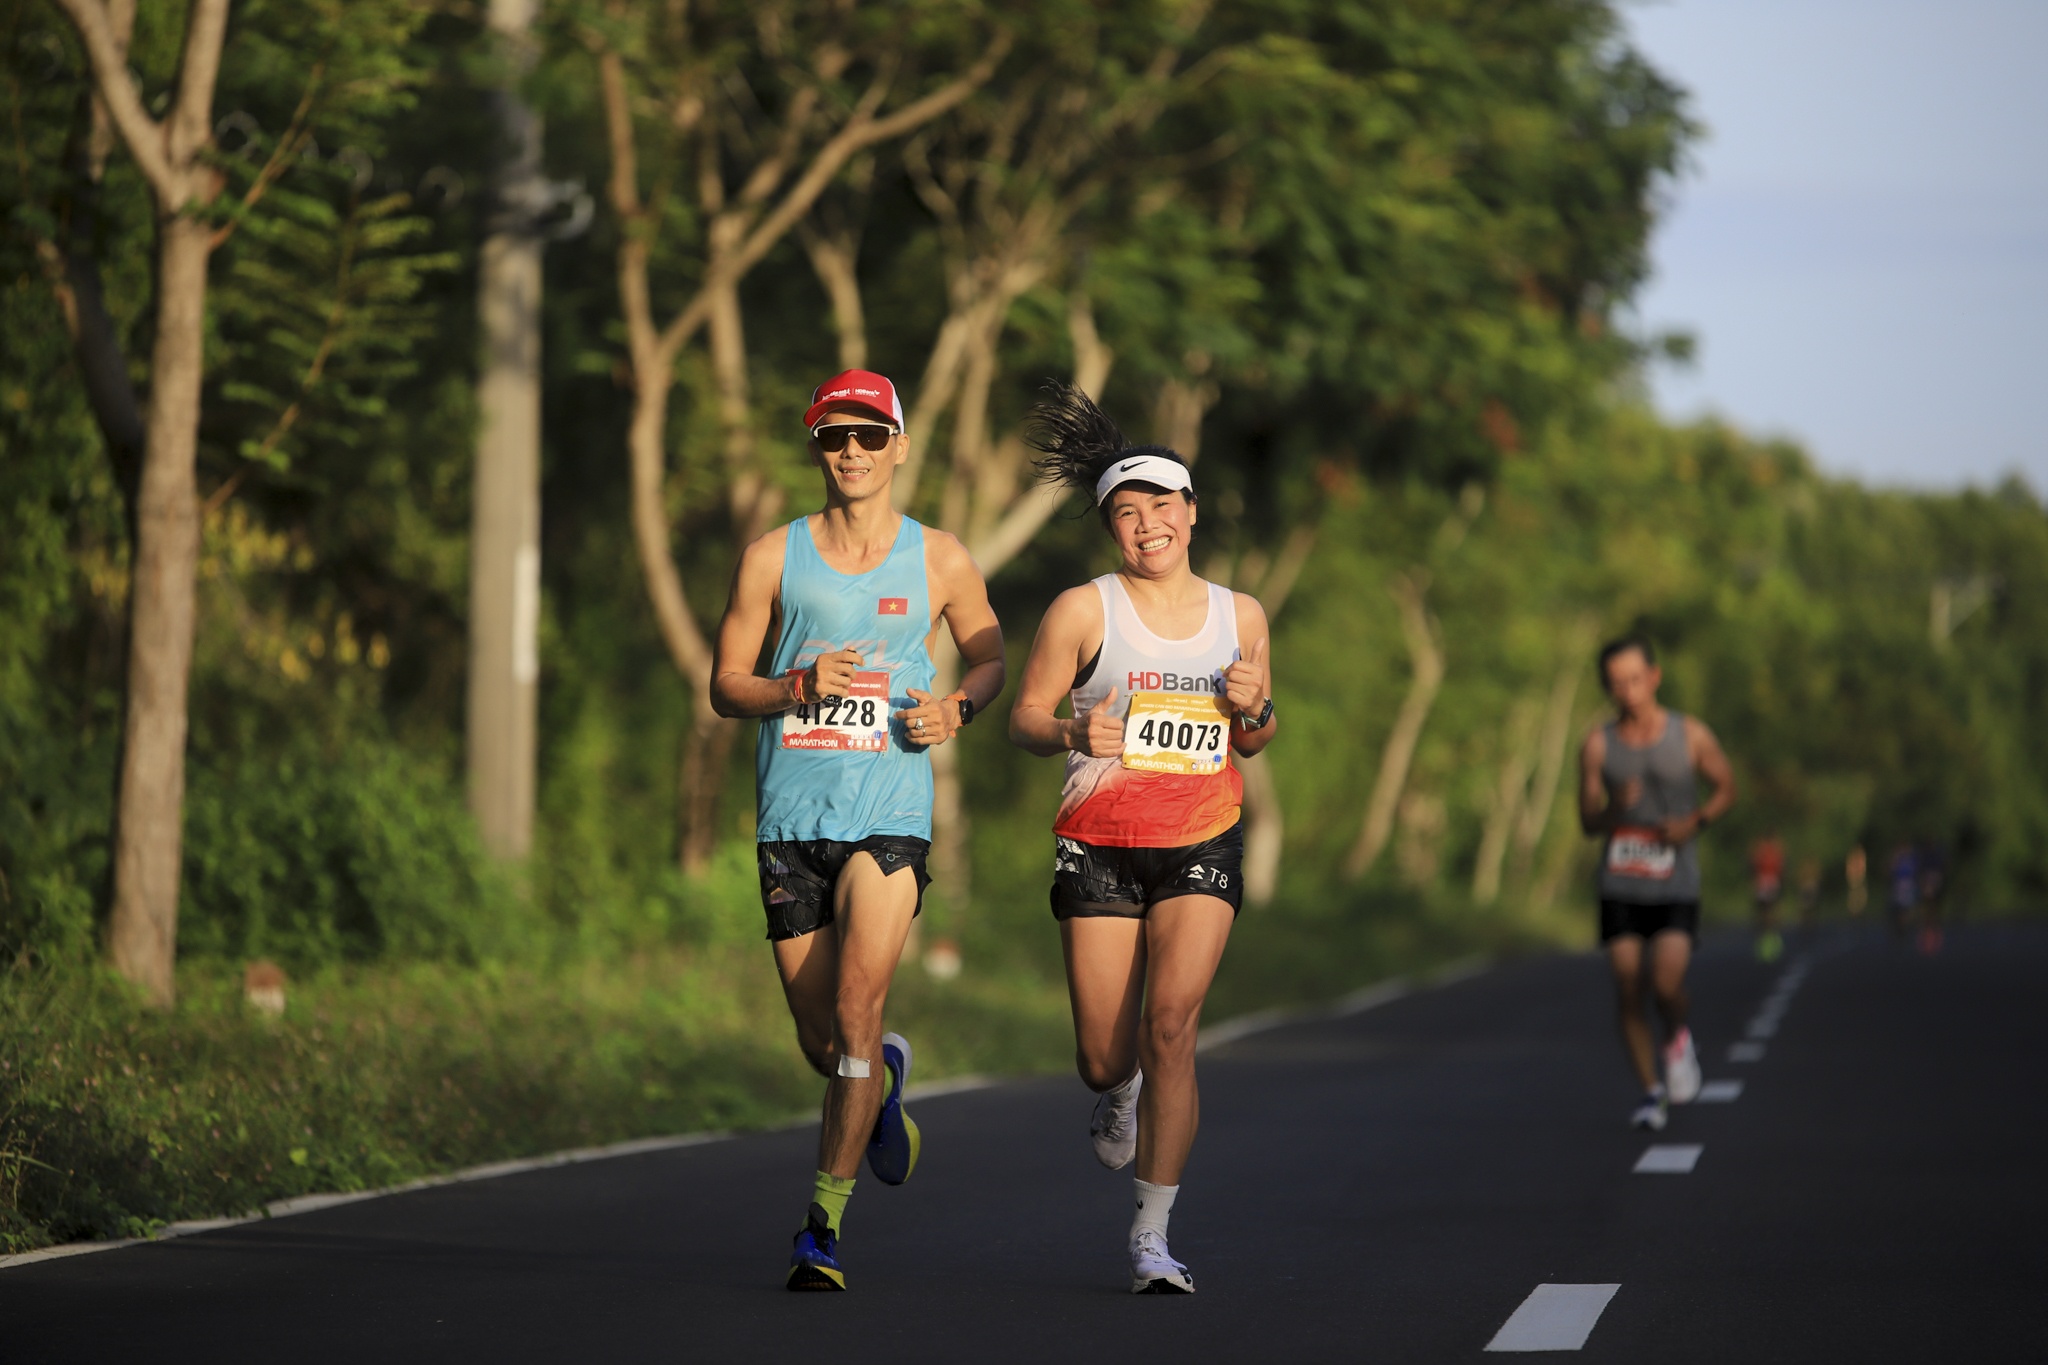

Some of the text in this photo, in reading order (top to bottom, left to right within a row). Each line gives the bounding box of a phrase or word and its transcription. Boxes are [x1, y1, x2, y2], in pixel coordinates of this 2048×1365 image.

[1127, 671, 1222, 694] HDBank
[789, 737, 838, 748] MARATHON
[1138, 719, 1222, 751] 40073
[1130, 758, 1185, 772] MARATHON
[1210, 867, 1228, 889] T8
